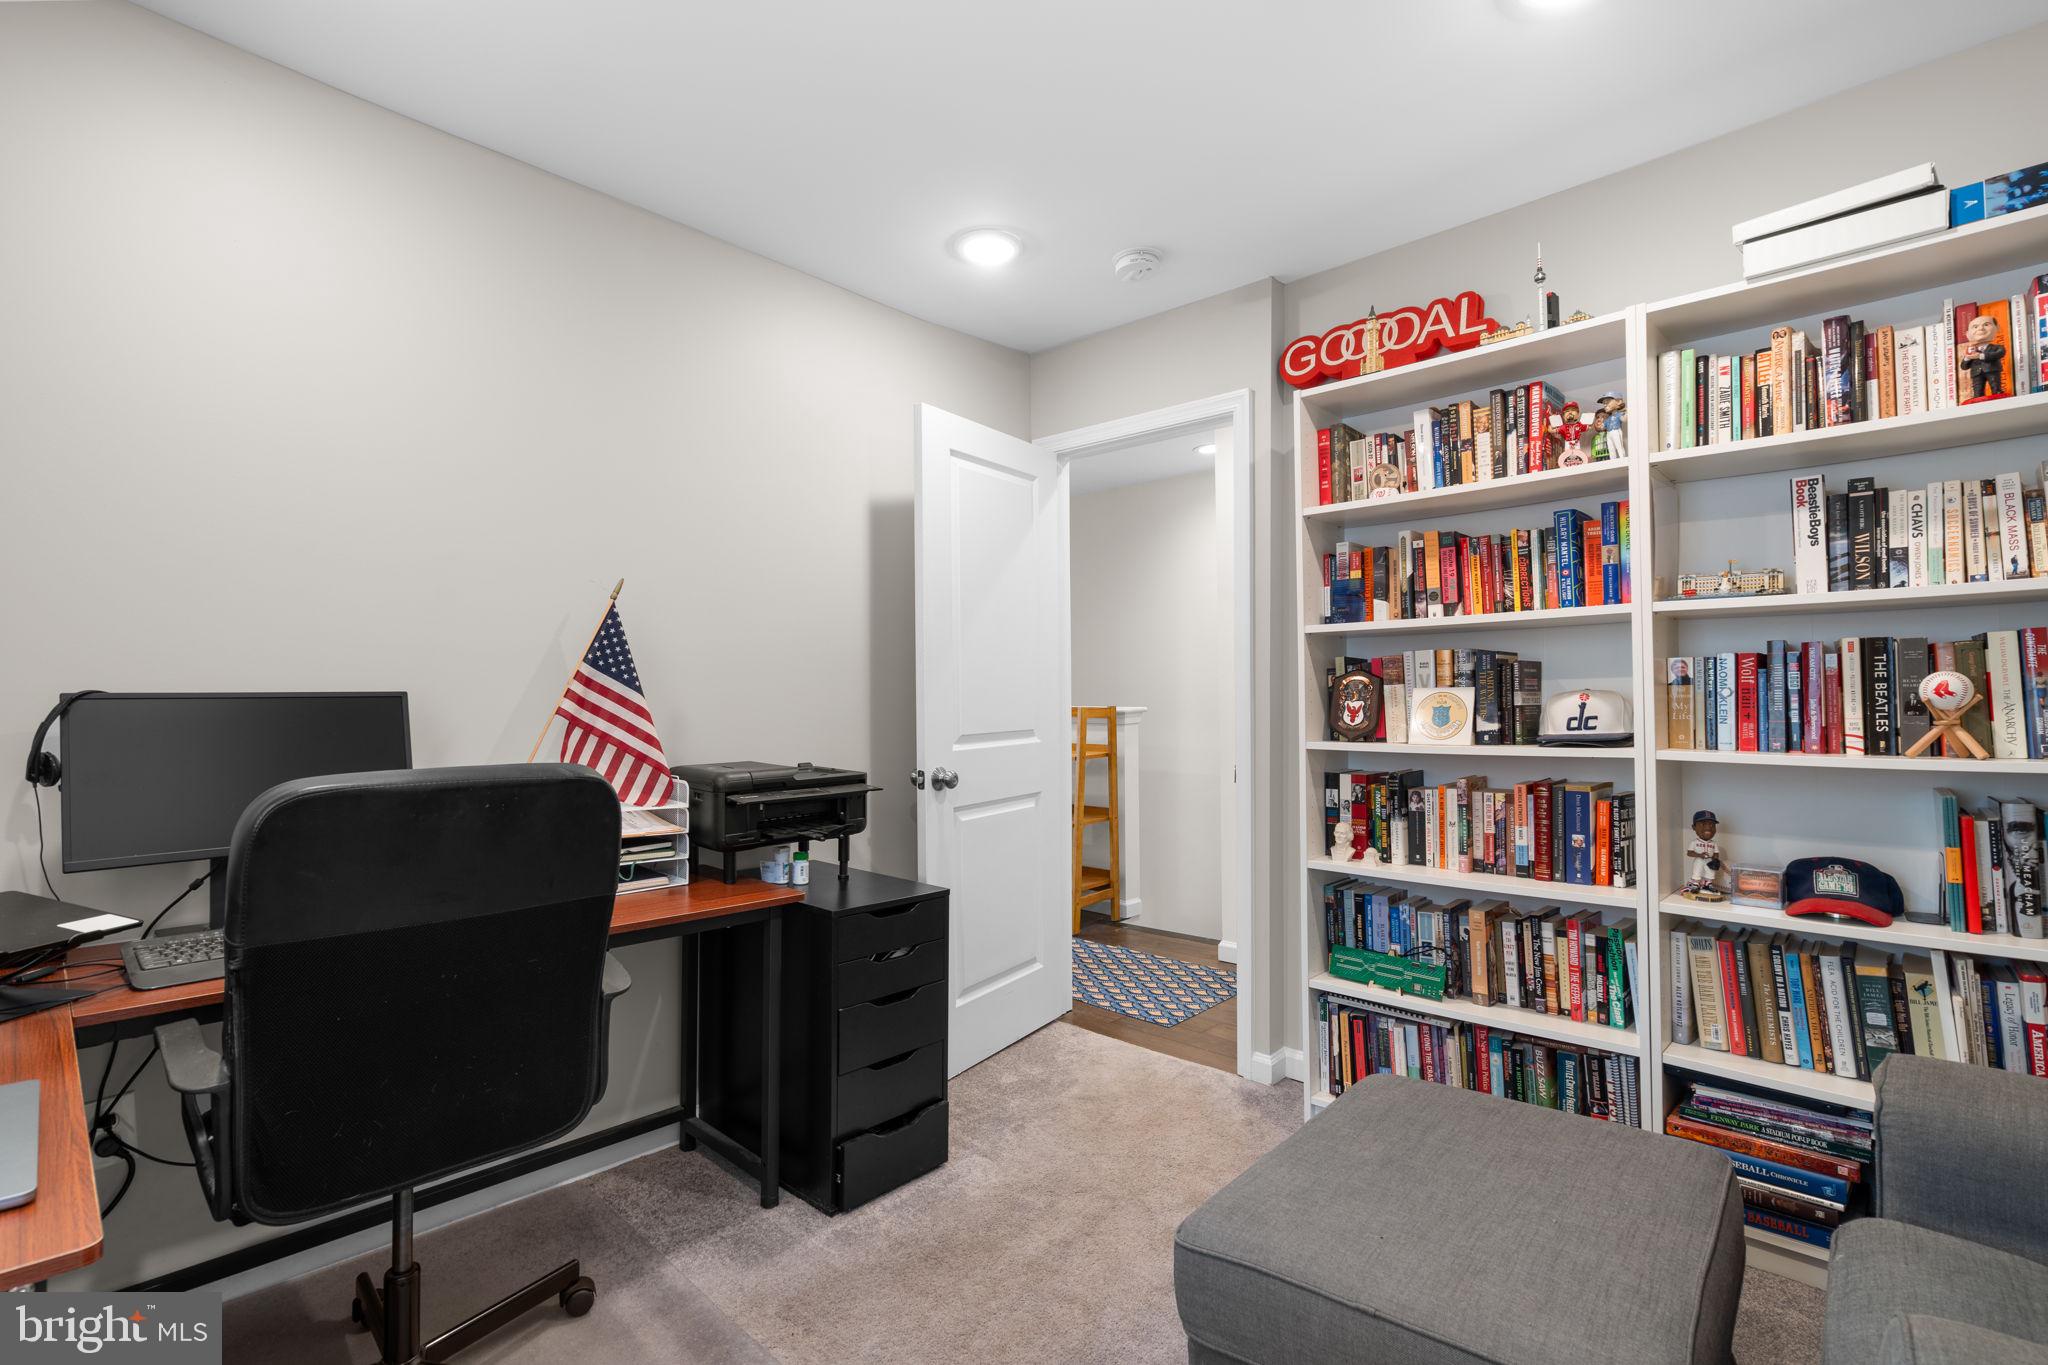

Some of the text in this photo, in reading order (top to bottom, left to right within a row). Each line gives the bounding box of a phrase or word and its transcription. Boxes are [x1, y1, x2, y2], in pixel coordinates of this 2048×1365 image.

[1758, 353, 1772, 404] ATTLEE Kenneth
[1904, 376, 1910, 384] OF
[1516, 397, 1524, 416] STREET
[1720, 365, 1730, 429] NW ZADIE SMITH
[1796, 480, 1808, 508] Book
[1559, 517, 1567, 539] HILARY
[1911, 504, 1923, 538] CHAVS
[1970, 519, 1979, 538] SUMMER
[2005, 493, 2019, 551] BLACK MASS
[1947, 508, 1960, 573] SOCCERNOMICS
[1855, 533, 1870, 580] WILSON
[2035, 547, 2043, 570] ANGELS
[1518, 557, 1530, 607] CORRECTIONS
[2025, 633, 2037, 668] CONFIDANTE
[2037, 644, 2046, 655] THE
[1741, 657, 1755, 683] Wolf
[1480, 689, 1488, 719] WATERS
[1719, 658, 1728, 724] NAOMI KLEIN
[1874, 654, 1888, 732] THE BEATLES
[1567, 702, 1598, 731] dc
[1672, 712, 1692, 721] Life
[1791, 710, 1799, 722] KLEIN
[2002, 689, 2017, 746] THE ANARCHY
[2021, 838, 2034, 916] JON MEACHAM
[1569, 929, 1579, 965] TIM HOWARD
[1608, 938, 1618, 971] Fashion
[1612, 929, 1622, 961] Passion
[1691, 938, 1713, 950] SHILTS
[1695, 955, 1714, 1002] AND THE BAND
[1772, 955, 1782, 975] COLONY
[1535, 979, 1543, 995] Crow
[1570, 972, 1580, 1004] THE KEEPER
[1776, 988, 1787, 1007] NATION
[1830, 981, 1838, 995] ACID
[1609, 985, 1623, 1025] The Clash
[1763, 984, 1776, 1046] The ALCHEMISTS
[1807, 988, 1816, 1020] AMERICA
[1833, 1011, 1841, 1023] THE
[2003, 993, 2016, 1016] Legacy
[1781, 1016, 1790, 1031] CHRIS
[2008, 1026, 2019, 1047] Honor
[1480, 1040, 1488, 1052] New
[1783, 1033, 1792, 1050] HAYES
[1835, 1024, 1846, 1056] CHILDREN
[2032, 1030, 2046, 1076] AMERICA
[1535, 1050, 1547, 1099] BUZZ SAW
[1565, 1060, 1575, 1090] BATTLE CRY
[1592, 1071, 1600, 1099] WILLIAMS
[1710, 1114, 1828, 1148] FENWAY PARK STADIUM BOOK
[1770, 1171, 1809, 1186] CHRONICLE
[1748, 1212, 1809, 1238] BASEBALL
